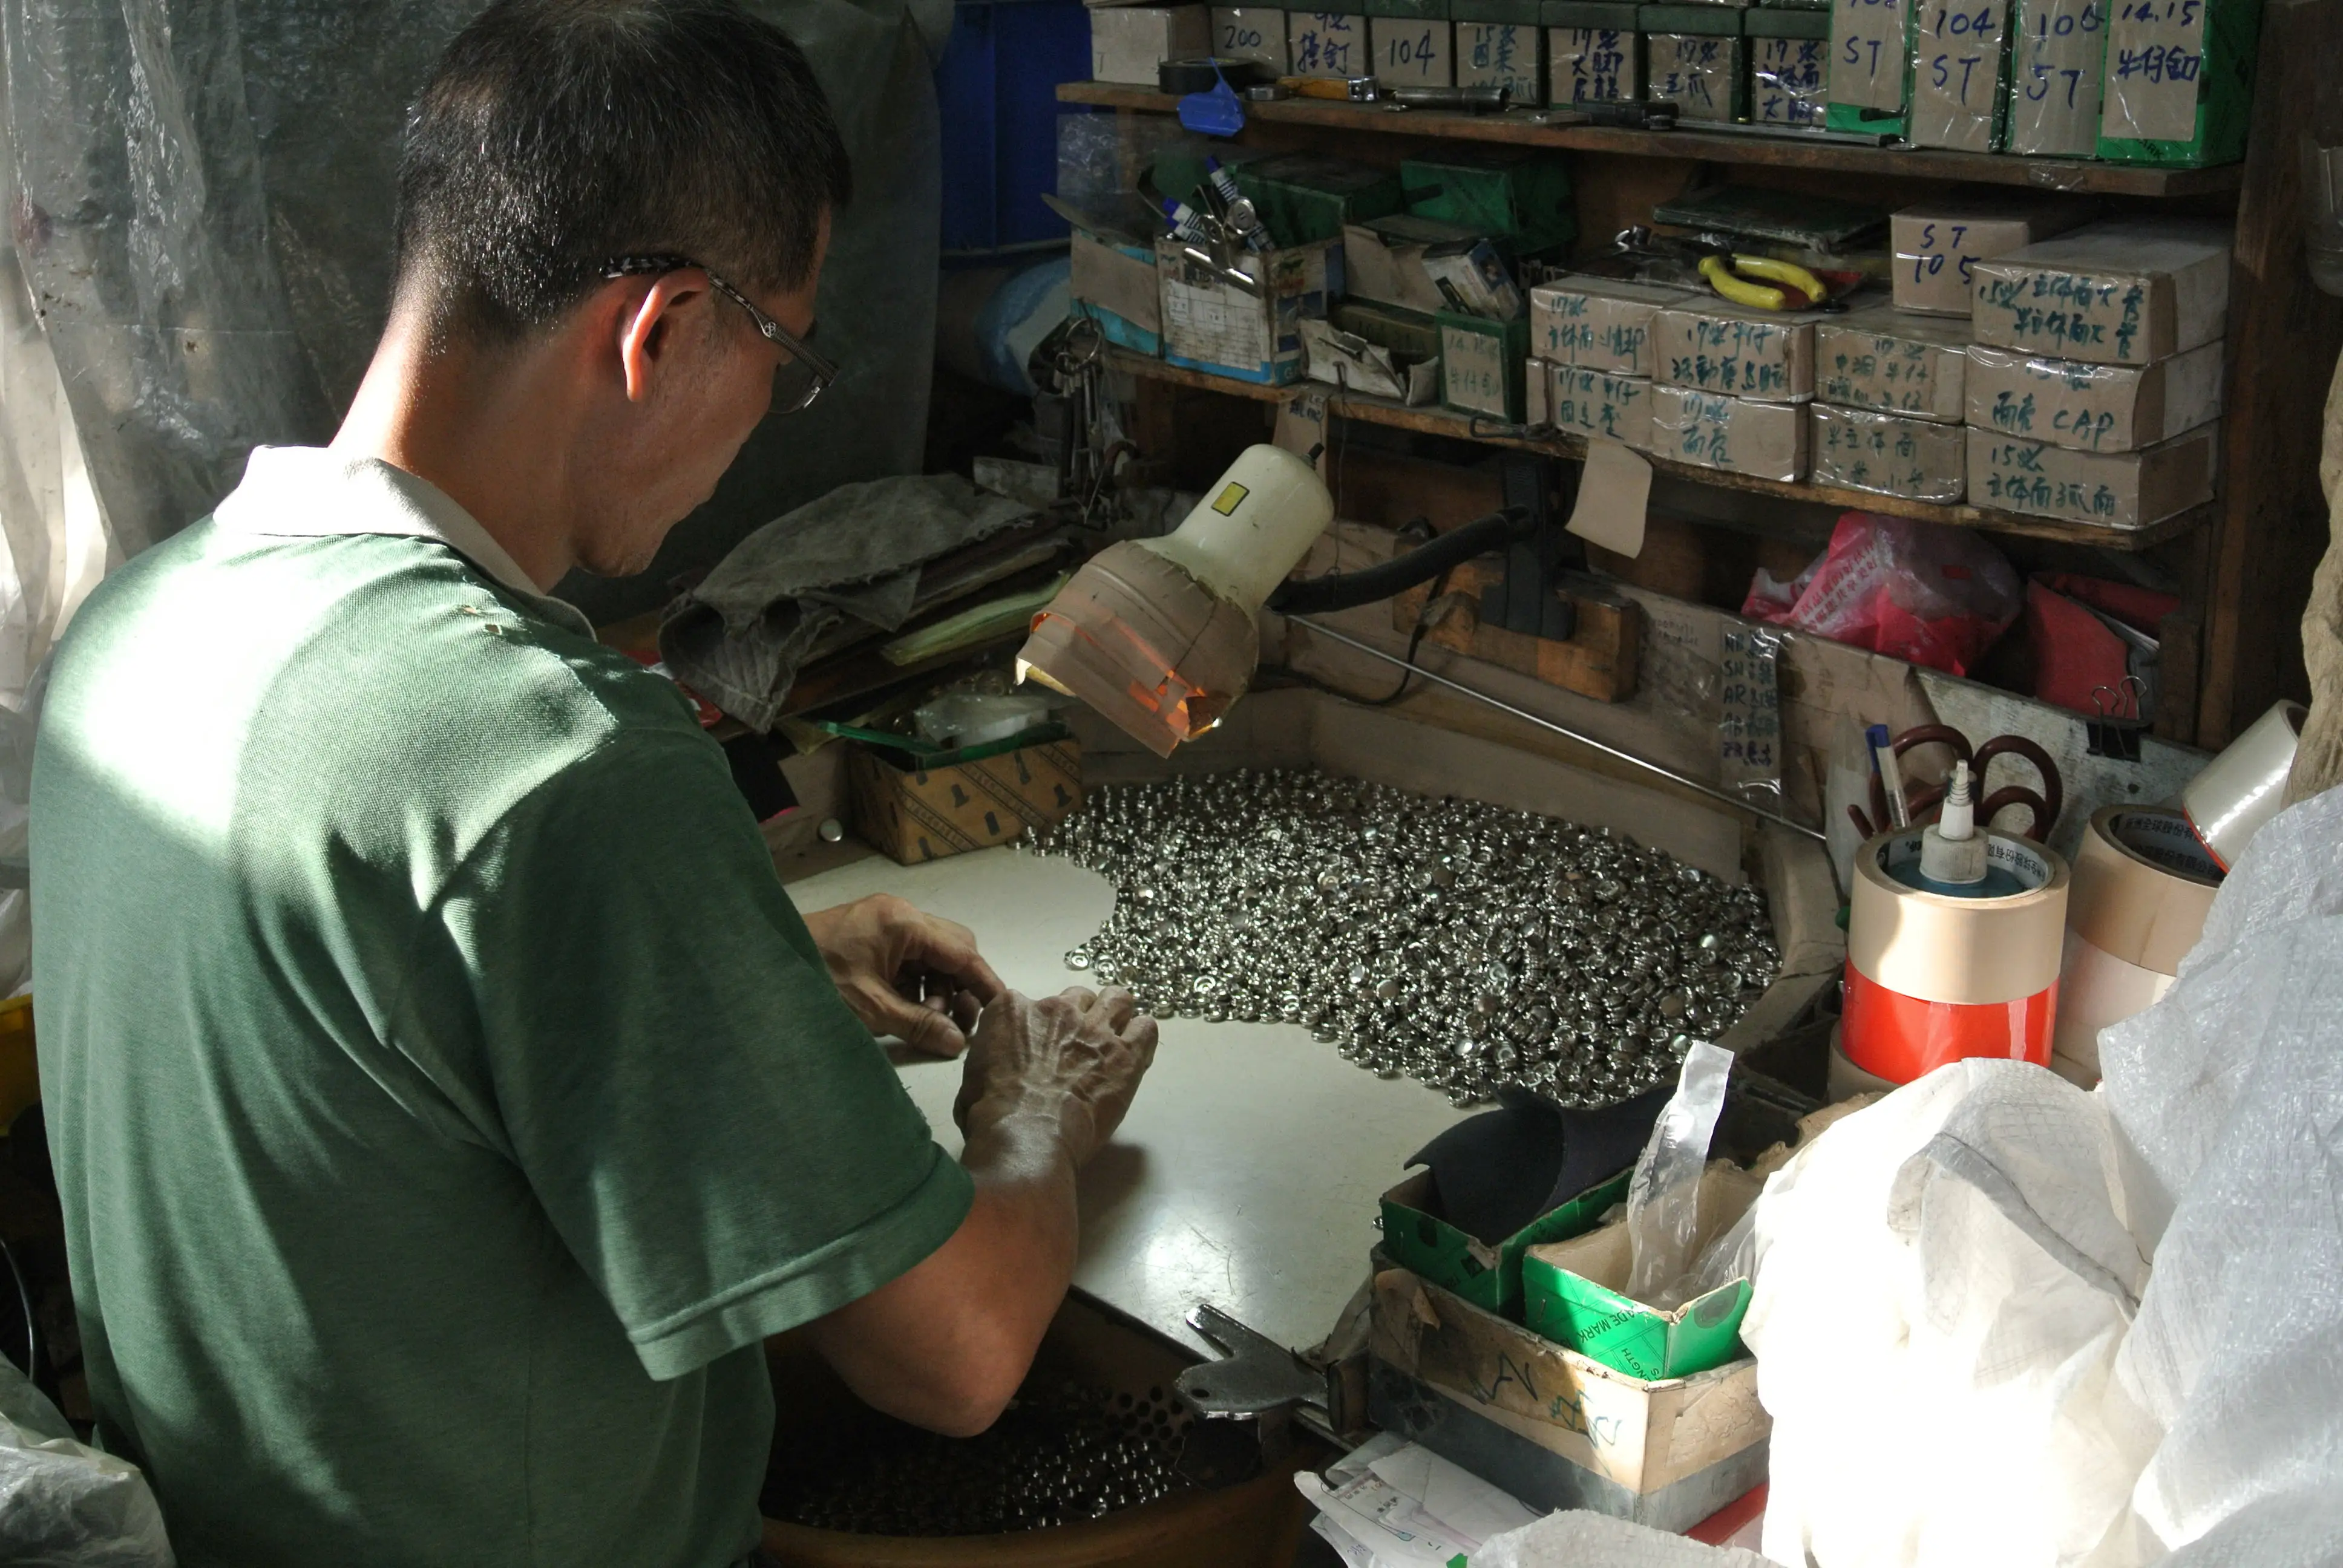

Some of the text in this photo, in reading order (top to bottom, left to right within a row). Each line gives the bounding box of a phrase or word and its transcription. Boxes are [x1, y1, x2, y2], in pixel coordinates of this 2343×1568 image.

[1224, 26, 1262, 50] 200
[1936, 7, 1996, 39] 104
[1391, 29, 1435, 76] 104
[1915, 253, 1981, 285] 105
[2053, 408, 2115, 449] CAP
[1577, 1318, 1613, 1344] MARK
